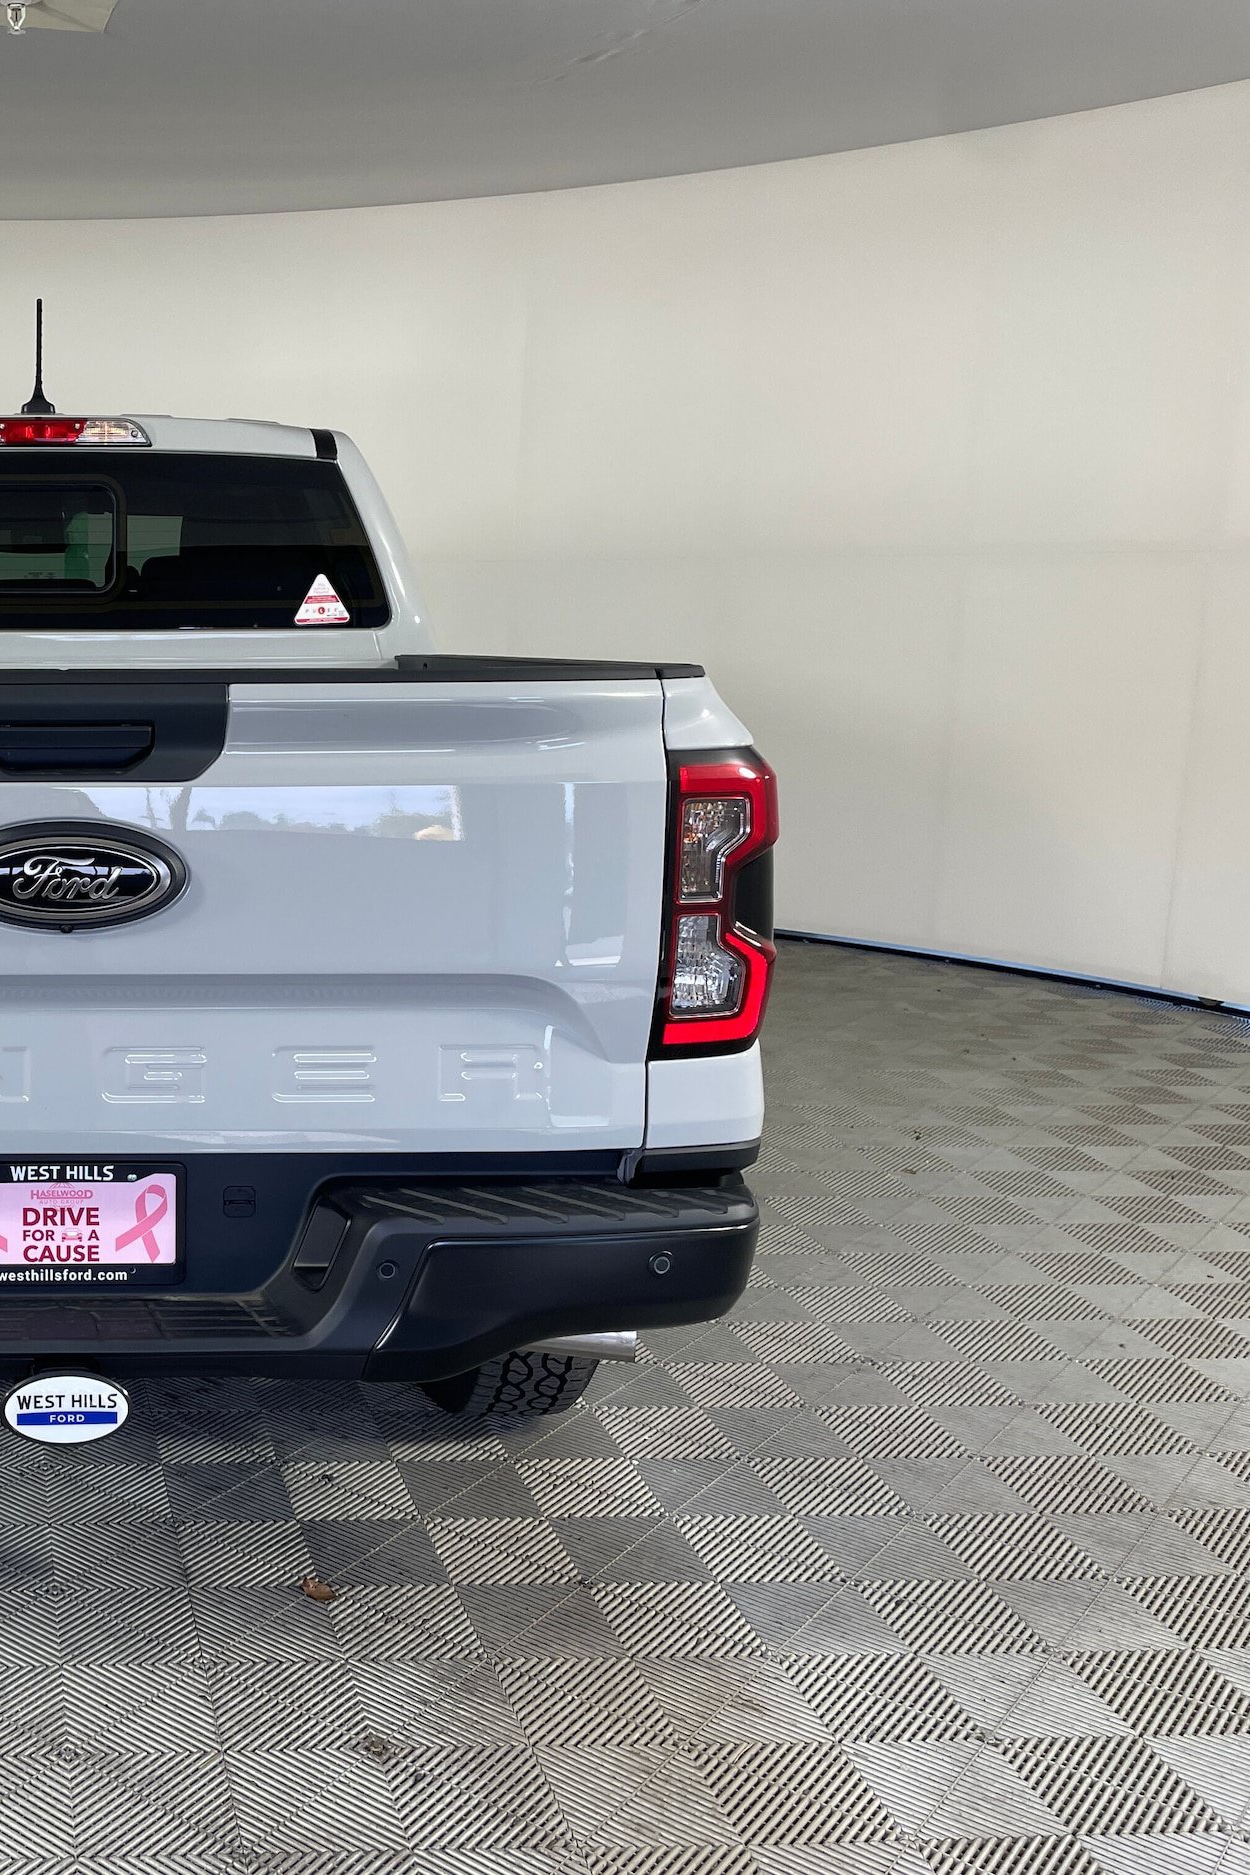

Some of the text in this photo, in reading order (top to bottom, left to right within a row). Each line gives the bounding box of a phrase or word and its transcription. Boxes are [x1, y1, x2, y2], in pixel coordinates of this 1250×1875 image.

[12, 855, 124, 900] Ford
[10, 1165, 114, 1181] WEST HILLS
[30, 1189, 93, 1200] HASELWOOD
[22, 1207, 100, 1226] DRIVE
[22, 1229, 100, 1242] FOR A
[23, 1245, 100, 1263] CAUSE
[16, 1393, 118, 1410] WEST HILLS
[49, 1414, 85, 1423] FORD
